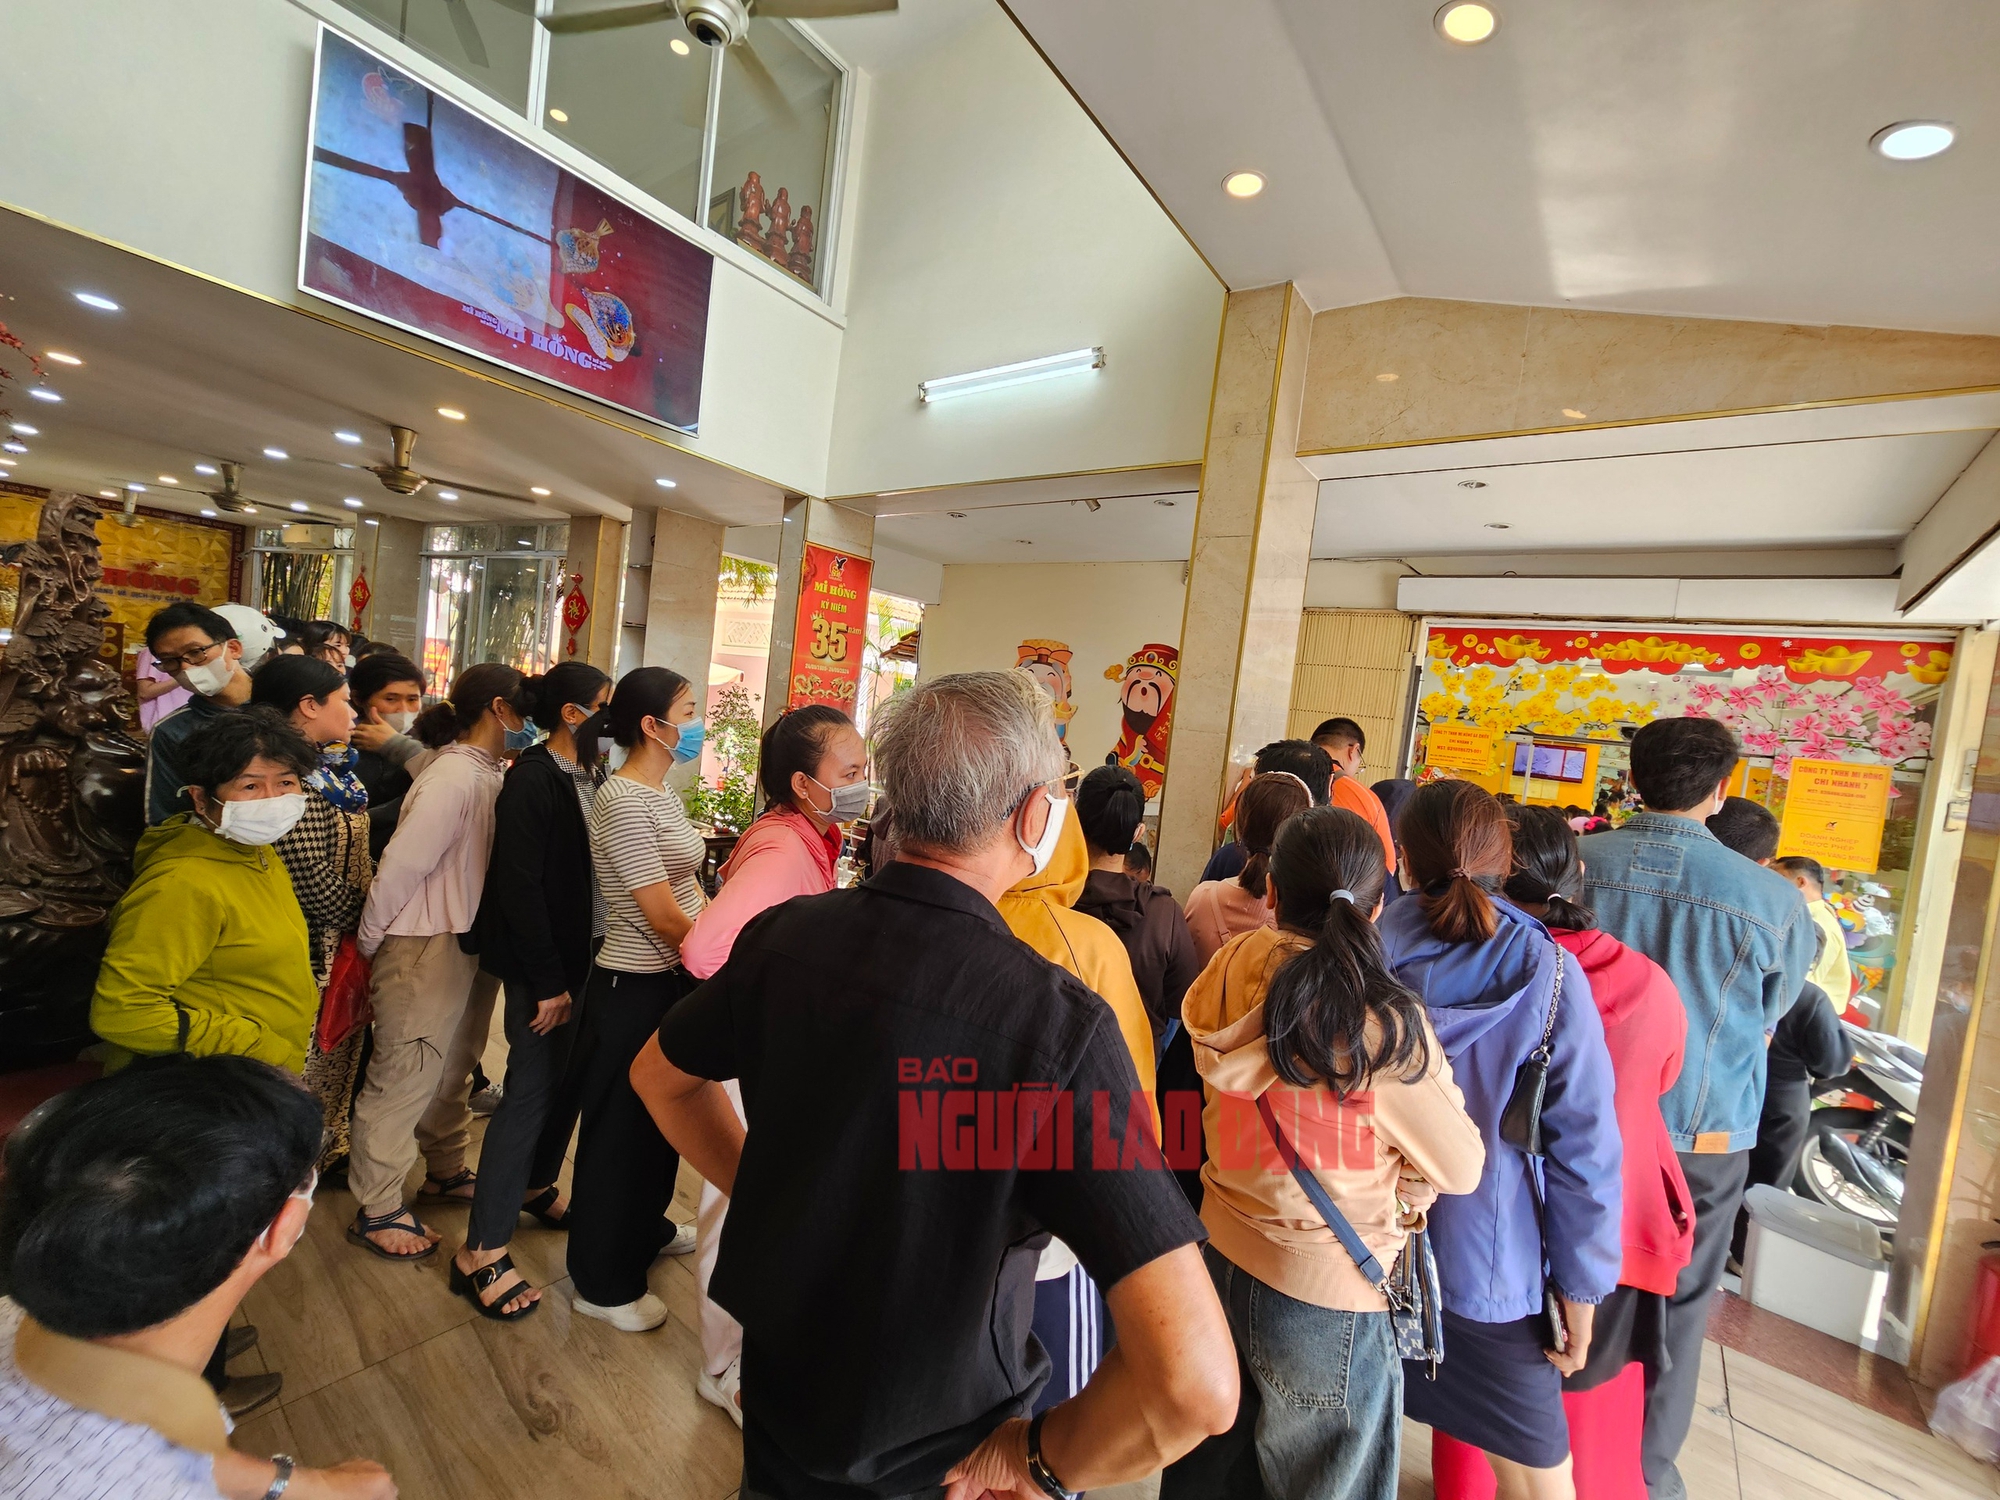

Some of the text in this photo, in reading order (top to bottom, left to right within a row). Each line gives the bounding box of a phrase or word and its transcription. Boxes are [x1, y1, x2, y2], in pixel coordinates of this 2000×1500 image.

[830, 583, 856, 600] HỒNG
[830, 602, 847, 614] NIỆM
[810, 618, 848, 661] 35
[1798, 765, 1817, 774] CÔNG
[1831, 769, 1849, 777] TNHH
